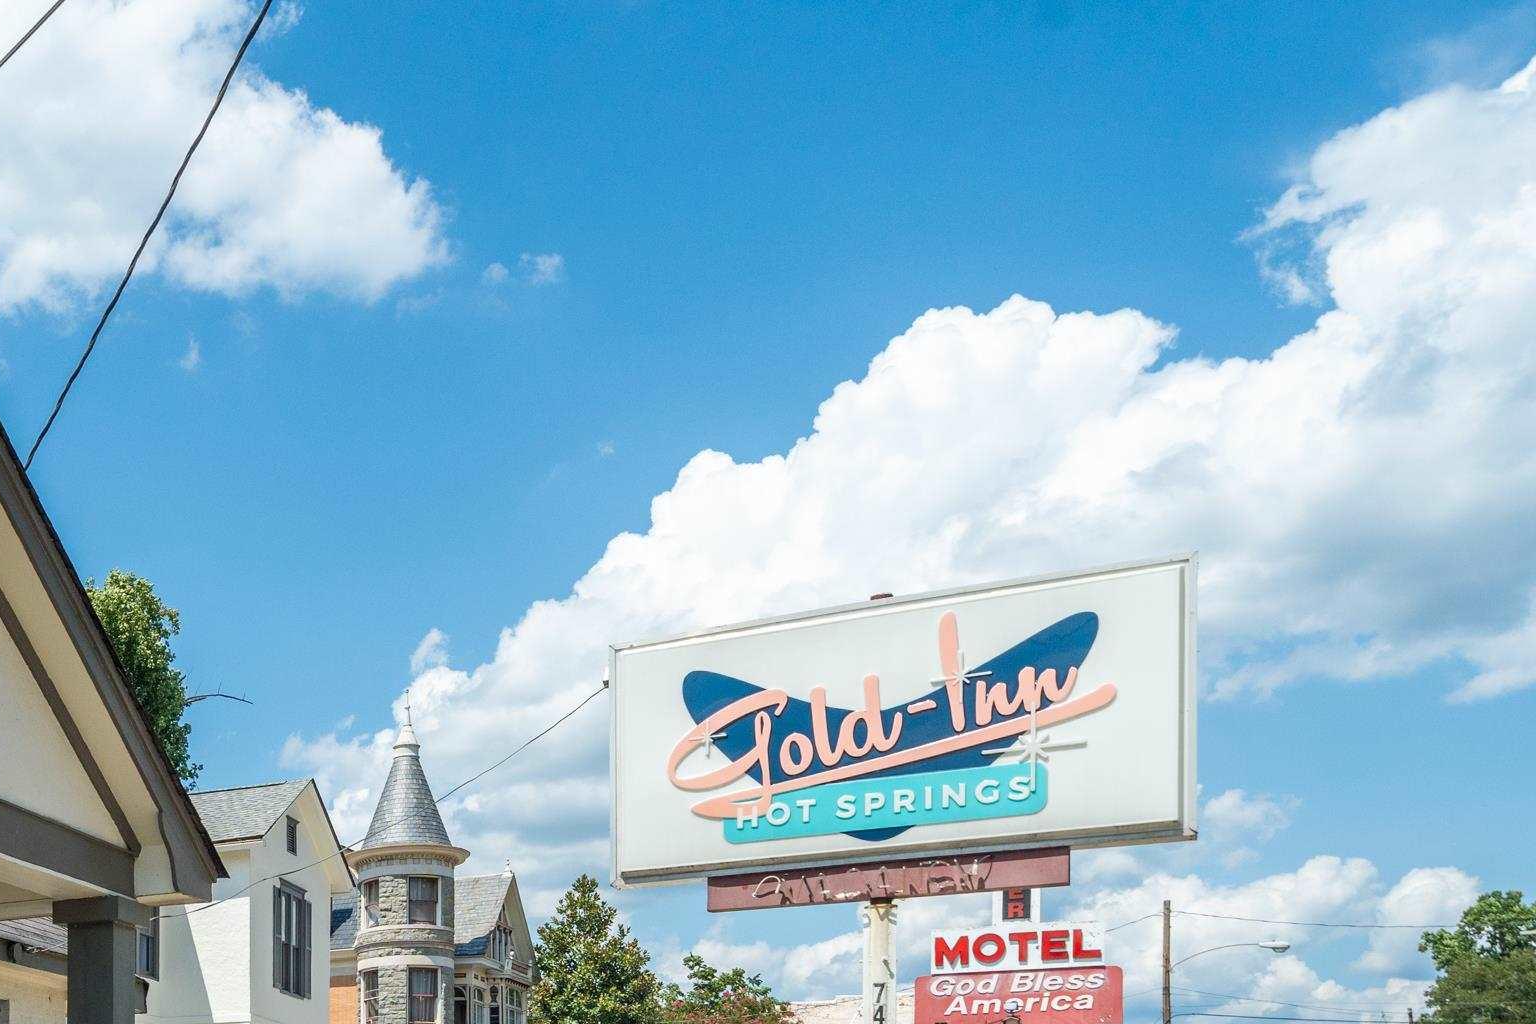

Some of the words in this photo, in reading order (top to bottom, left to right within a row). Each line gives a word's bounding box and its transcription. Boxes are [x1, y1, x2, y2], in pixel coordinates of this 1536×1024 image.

[736, 798, 817, 830] HOT
[835, 776, 1032, 819] SPRINGS
[934, 929, 1103, 968] MOTEL
[930, 974, 999, 996] God
[1010, 971, 1106, 994] Bless
